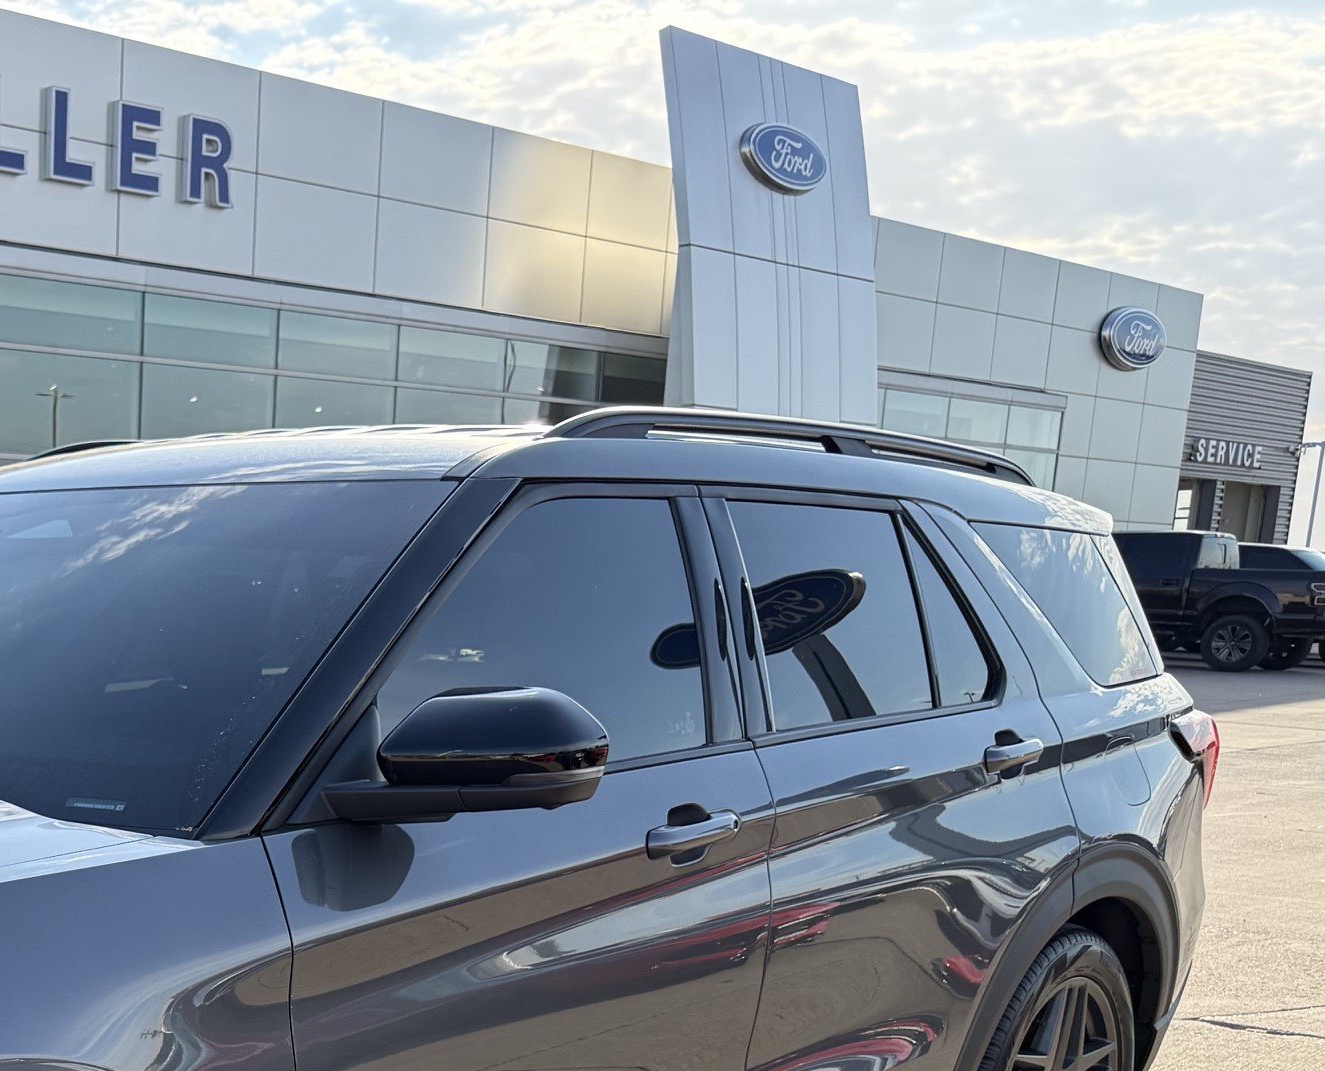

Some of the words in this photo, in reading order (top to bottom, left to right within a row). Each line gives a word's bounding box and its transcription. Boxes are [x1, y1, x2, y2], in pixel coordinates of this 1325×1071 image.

[771, 135, 814, 177] Ford
[1125, 320, 1158, 356] Ford
[1196, 438, 1263, 468] SERVICE
